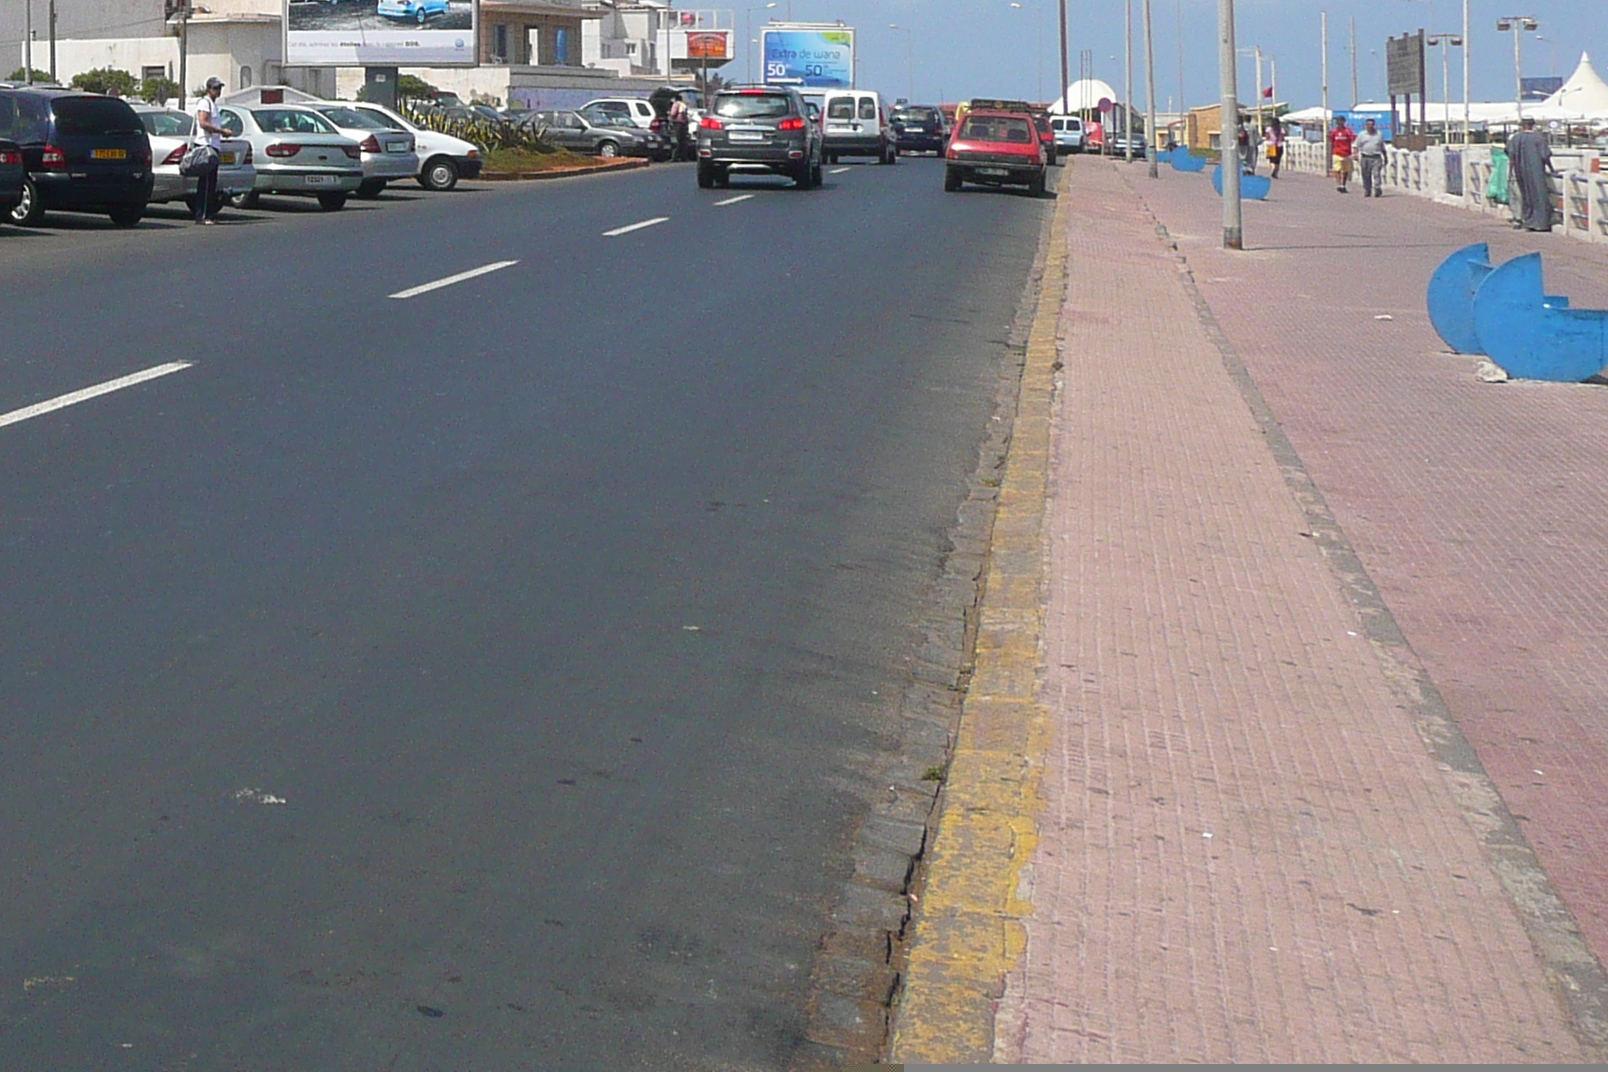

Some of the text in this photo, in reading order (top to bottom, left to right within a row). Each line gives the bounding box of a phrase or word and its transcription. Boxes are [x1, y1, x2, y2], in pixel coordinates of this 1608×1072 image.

[772, 49, 797, 59] Extra
[799, 49, 811, 59] de
[767, 64, 785, 76] 50
[805, 64, 823, 77] 50
